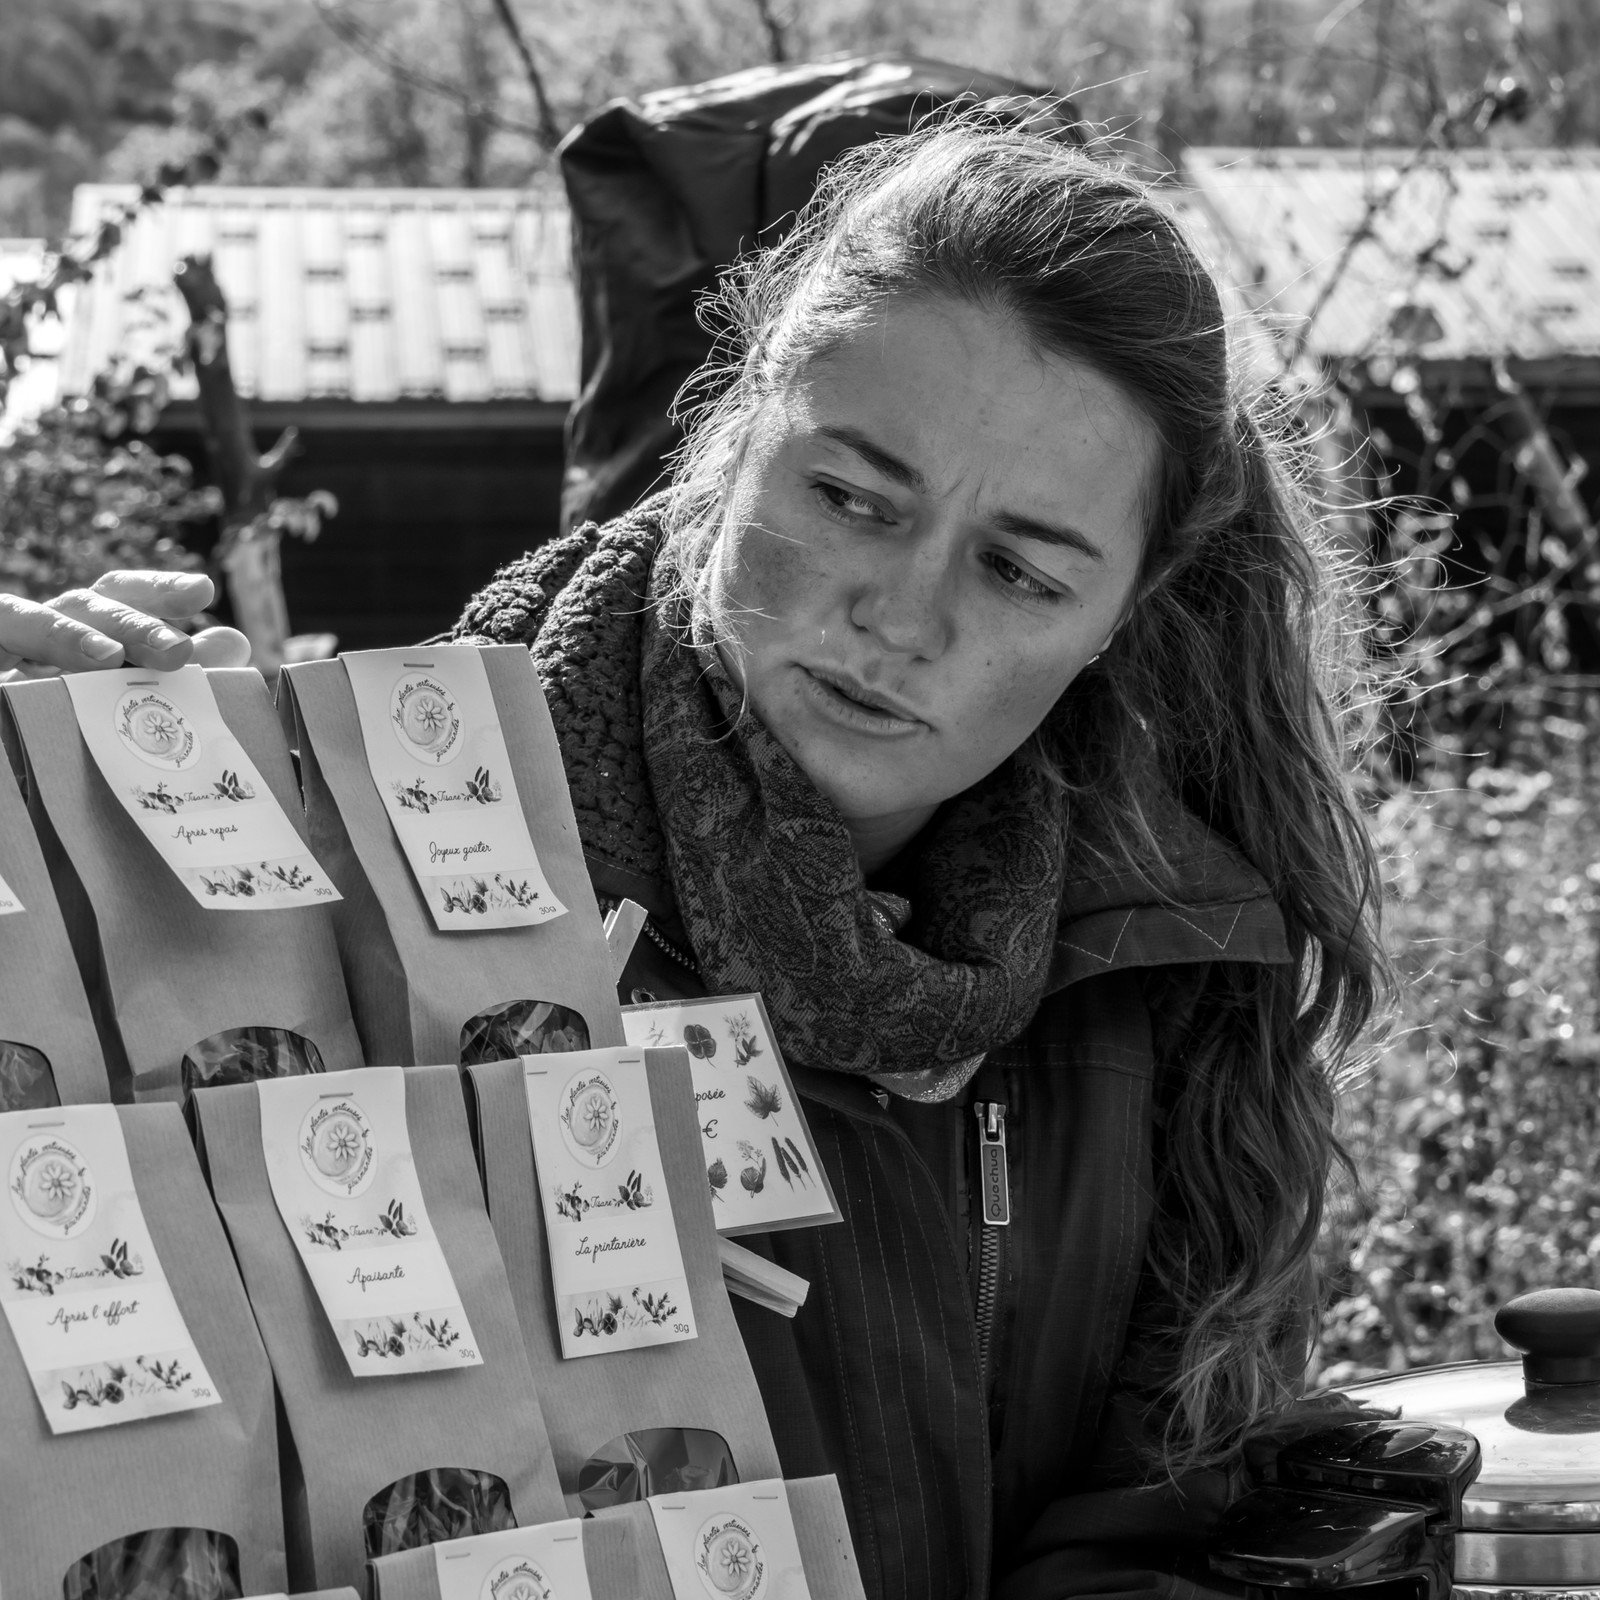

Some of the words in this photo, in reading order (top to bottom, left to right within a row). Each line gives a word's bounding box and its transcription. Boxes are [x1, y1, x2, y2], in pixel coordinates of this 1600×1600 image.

[210, 825, 238, 841] repas
[429, 841, 460, 863] Joyeux
[314, 888, 332, 896] 30g
[539, 906, 556, 914] 30g
[990, 1149, 1001, 1217] Quechua
[591, 1196, 612, 1208] Tisane
[575, 1236, 592, 1255] La
[592, 1236, 646, 1263] printanière
[347, 1265, 405, 1292] Apaisante
[674, 1323, 689, 1333] 30g
[459, 1349, 475, 1359] 30g
[192, 1388, 210, 1398] 30g
